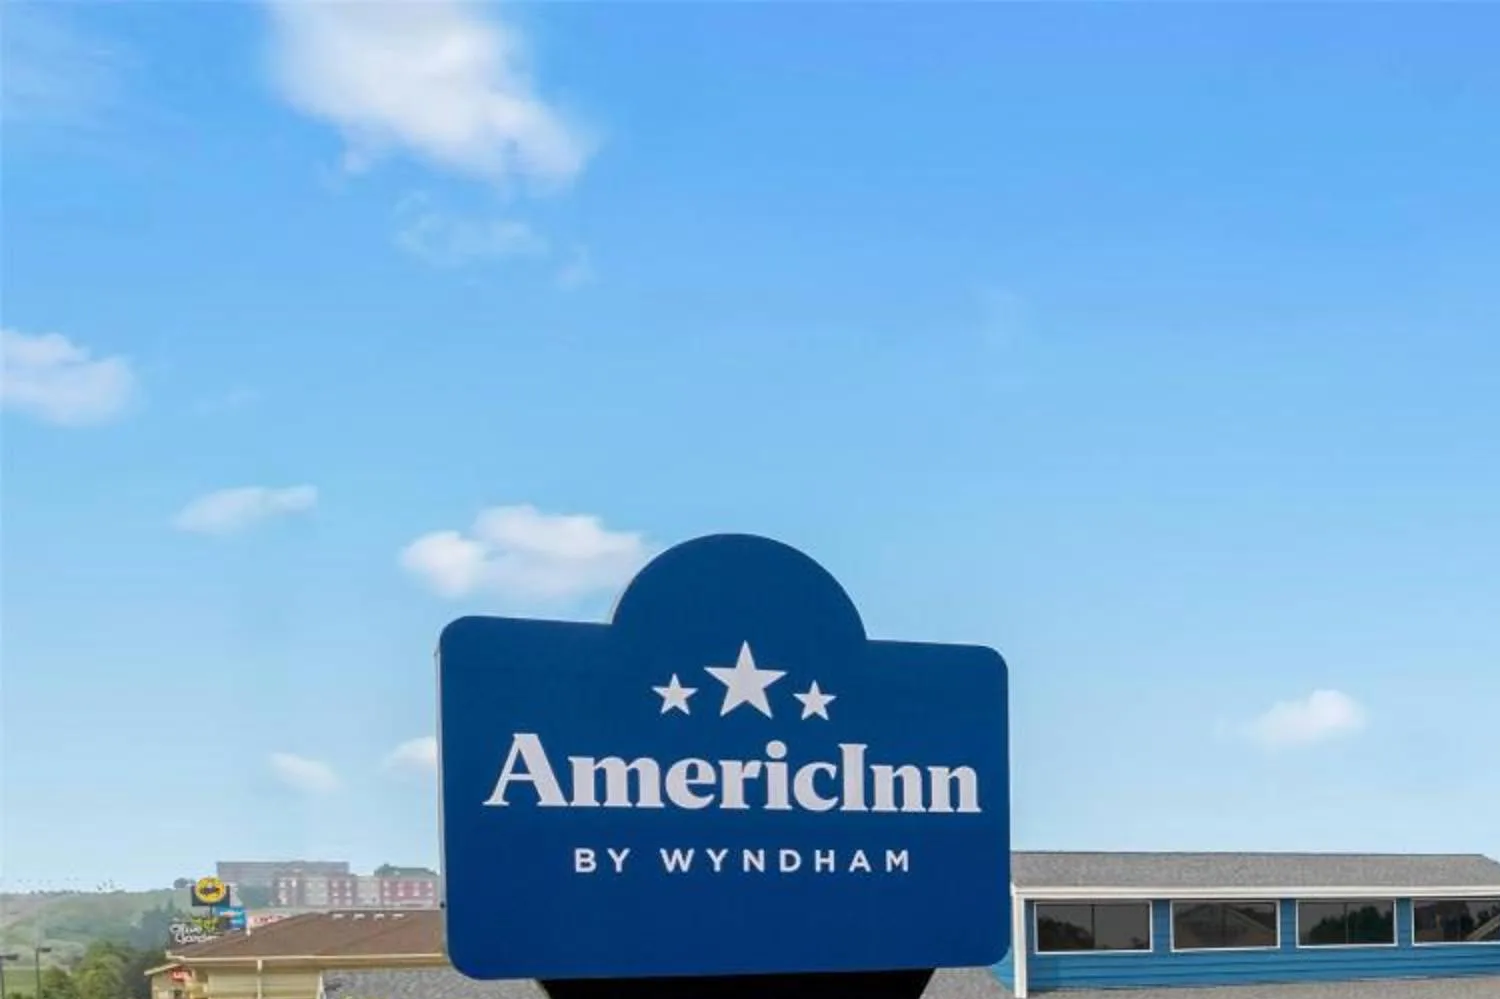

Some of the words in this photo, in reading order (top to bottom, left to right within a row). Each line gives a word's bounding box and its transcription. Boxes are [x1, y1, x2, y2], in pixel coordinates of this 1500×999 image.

[483, 733, 981, 813] AmericInn
[574, 848, 630, 873] BY
[660, 848, 910, 873] WYNDHAM
